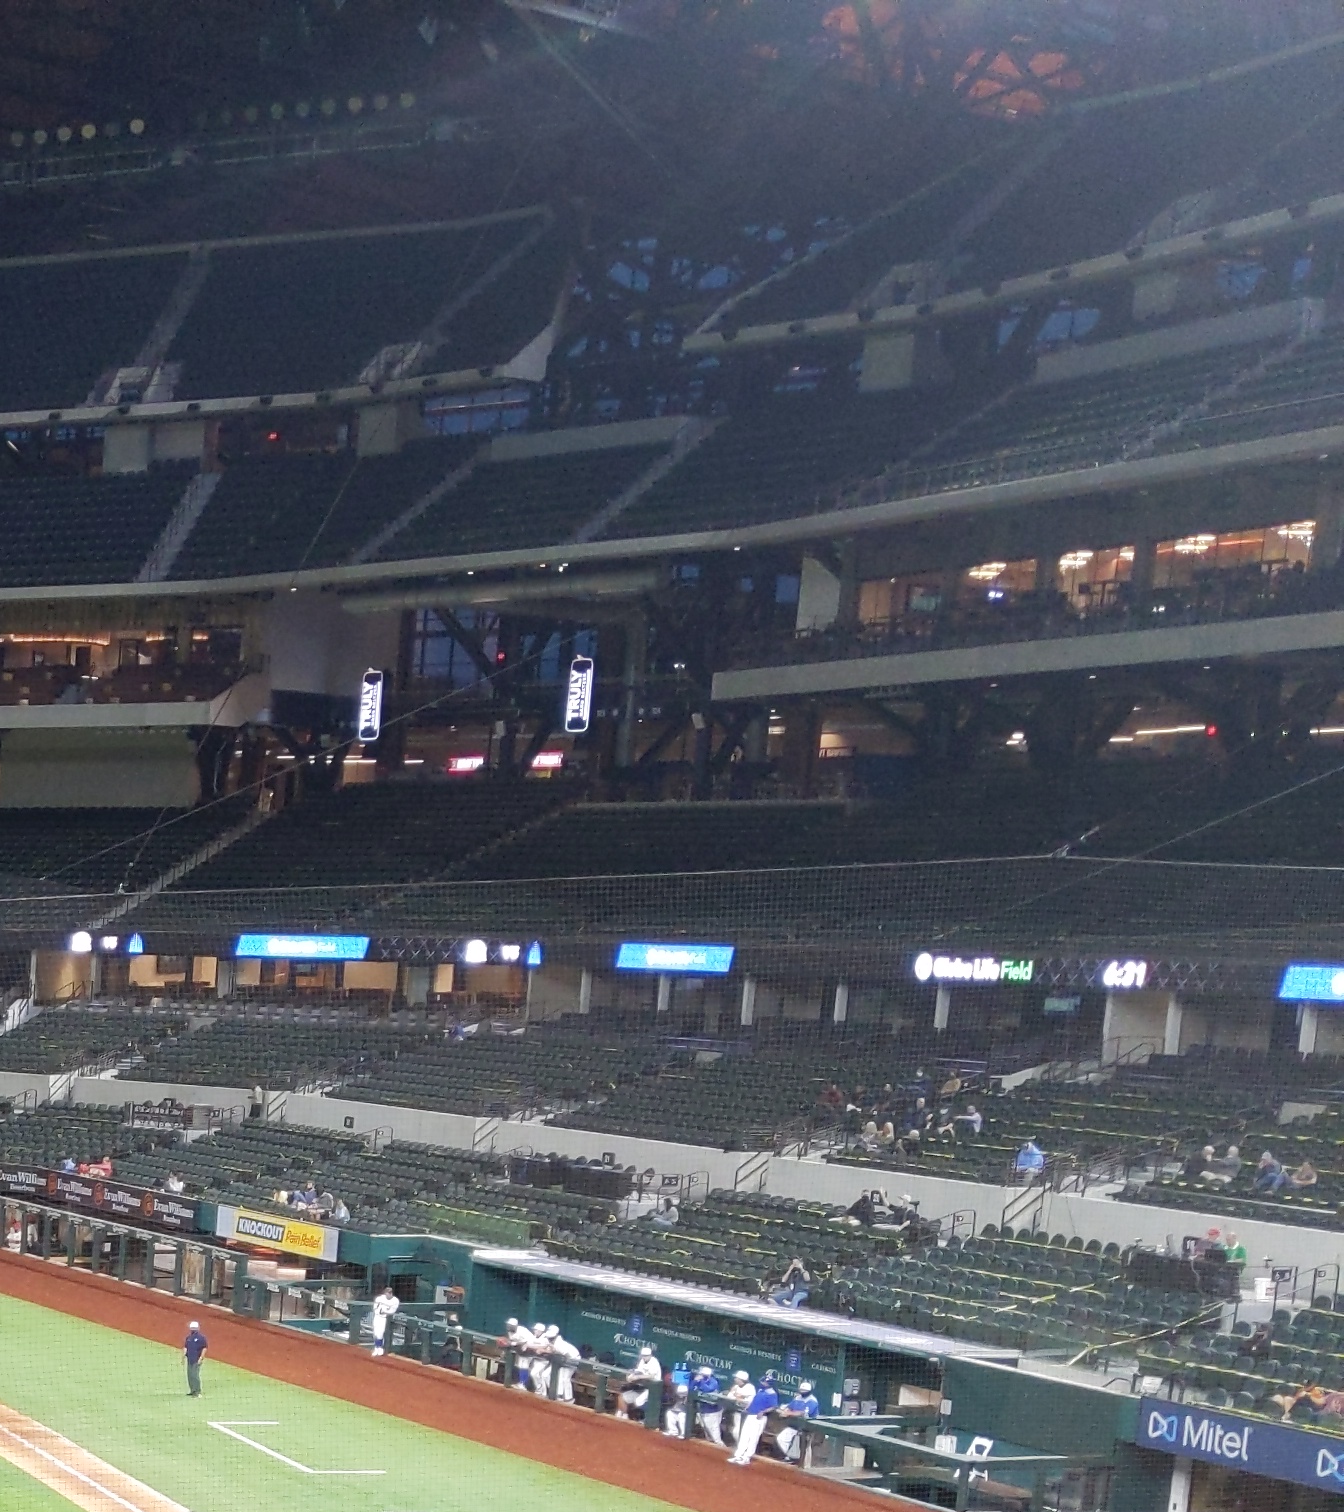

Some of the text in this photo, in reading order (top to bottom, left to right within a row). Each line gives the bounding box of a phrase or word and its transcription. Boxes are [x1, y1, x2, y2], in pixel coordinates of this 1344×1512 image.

[360, 681, 374, 731] TRULY
[567, 670, 582, 722] TRULY
[1000, 960, 1033, 982] Field
[238, 1217, 286, 1240] KNOCKOUT
[285, 1230, 321, 1249] Pain Relief
[689, 1351, 734, 1370] CHOCTAW
[1182, 1415, 1249, 1462] Mitel
